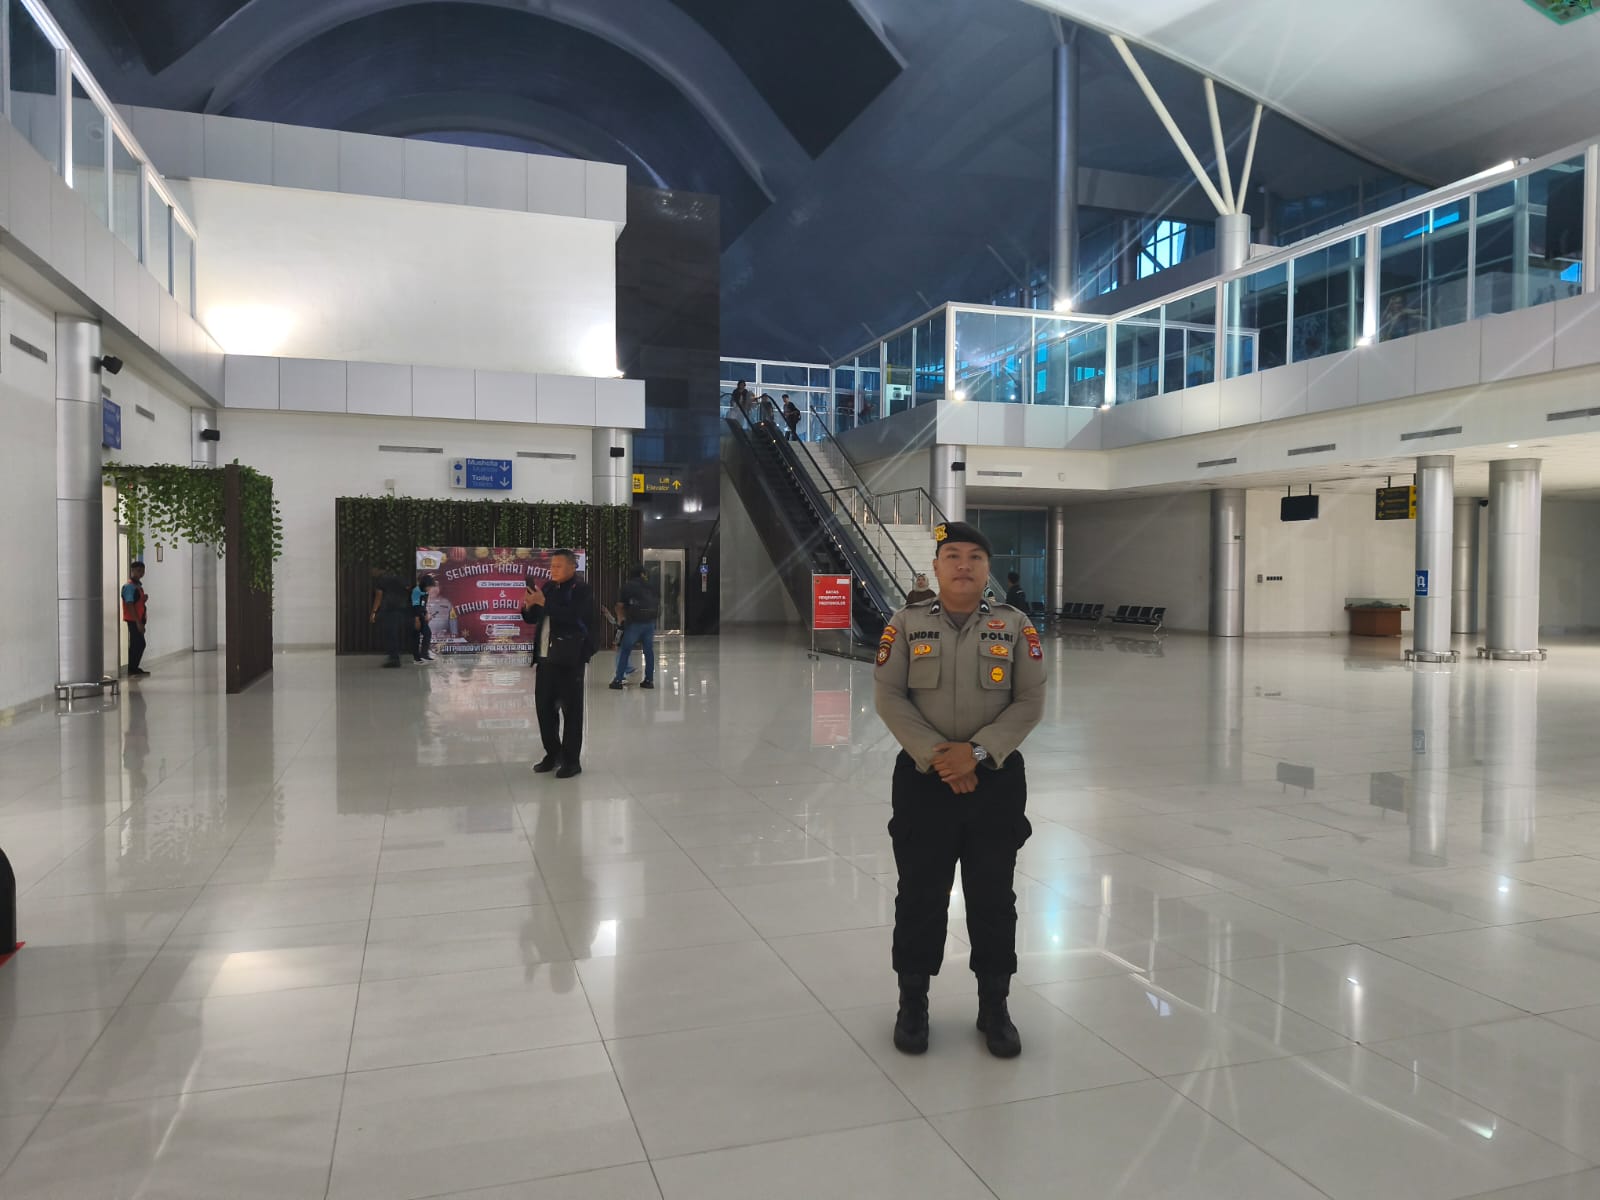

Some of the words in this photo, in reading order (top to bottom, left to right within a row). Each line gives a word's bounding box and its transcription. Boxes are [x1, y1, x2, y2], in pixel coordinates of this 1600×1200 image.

[471, 474, 494, 482] Toilet
[446, 563, 495, 581] SELAMAT
[498, 563, 523, 575] HARI
[527, 565, 552, 580] NATA
[499, 589, 507, 598] &
[455, 600, 489, 615] TAHUN
[492, 599, 520, 610] BARU
[908, 631, 940, 642] ANDRE
[980, 632, 1014, 643] POLRI
